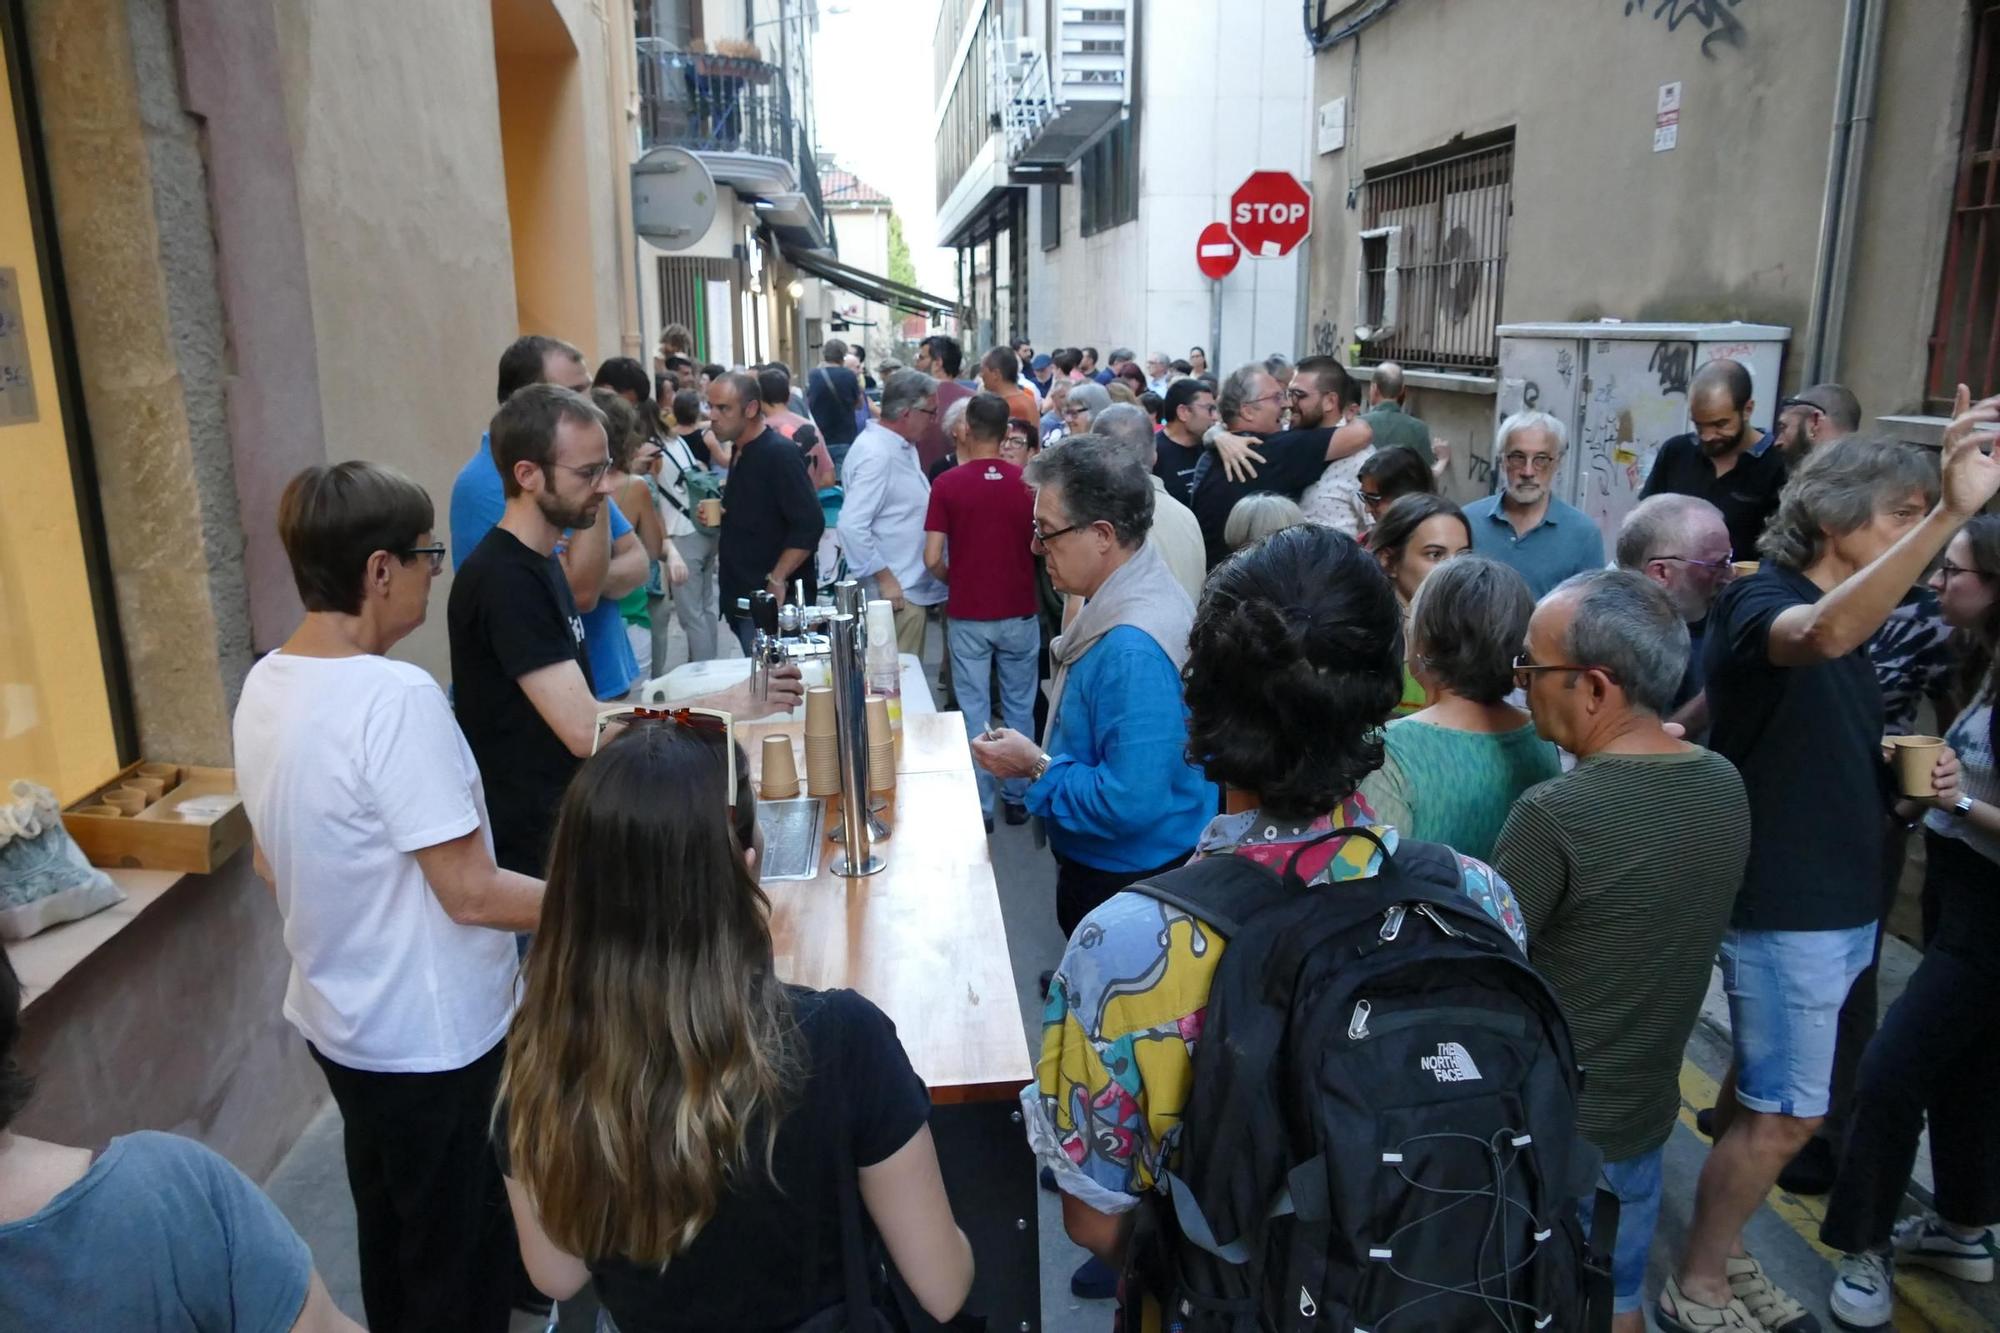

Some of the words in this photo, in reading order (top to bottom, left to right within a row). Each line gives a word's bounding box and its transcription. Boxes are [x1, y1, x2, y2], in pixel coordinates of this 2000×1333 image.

[1235, 202, 1305, 225] STOP
[1437, 1042, 1456, 1056] THE
[1421, 1056, 1460, 1070] NORTH
[1434, 1069, 1464, 1081] FACE
